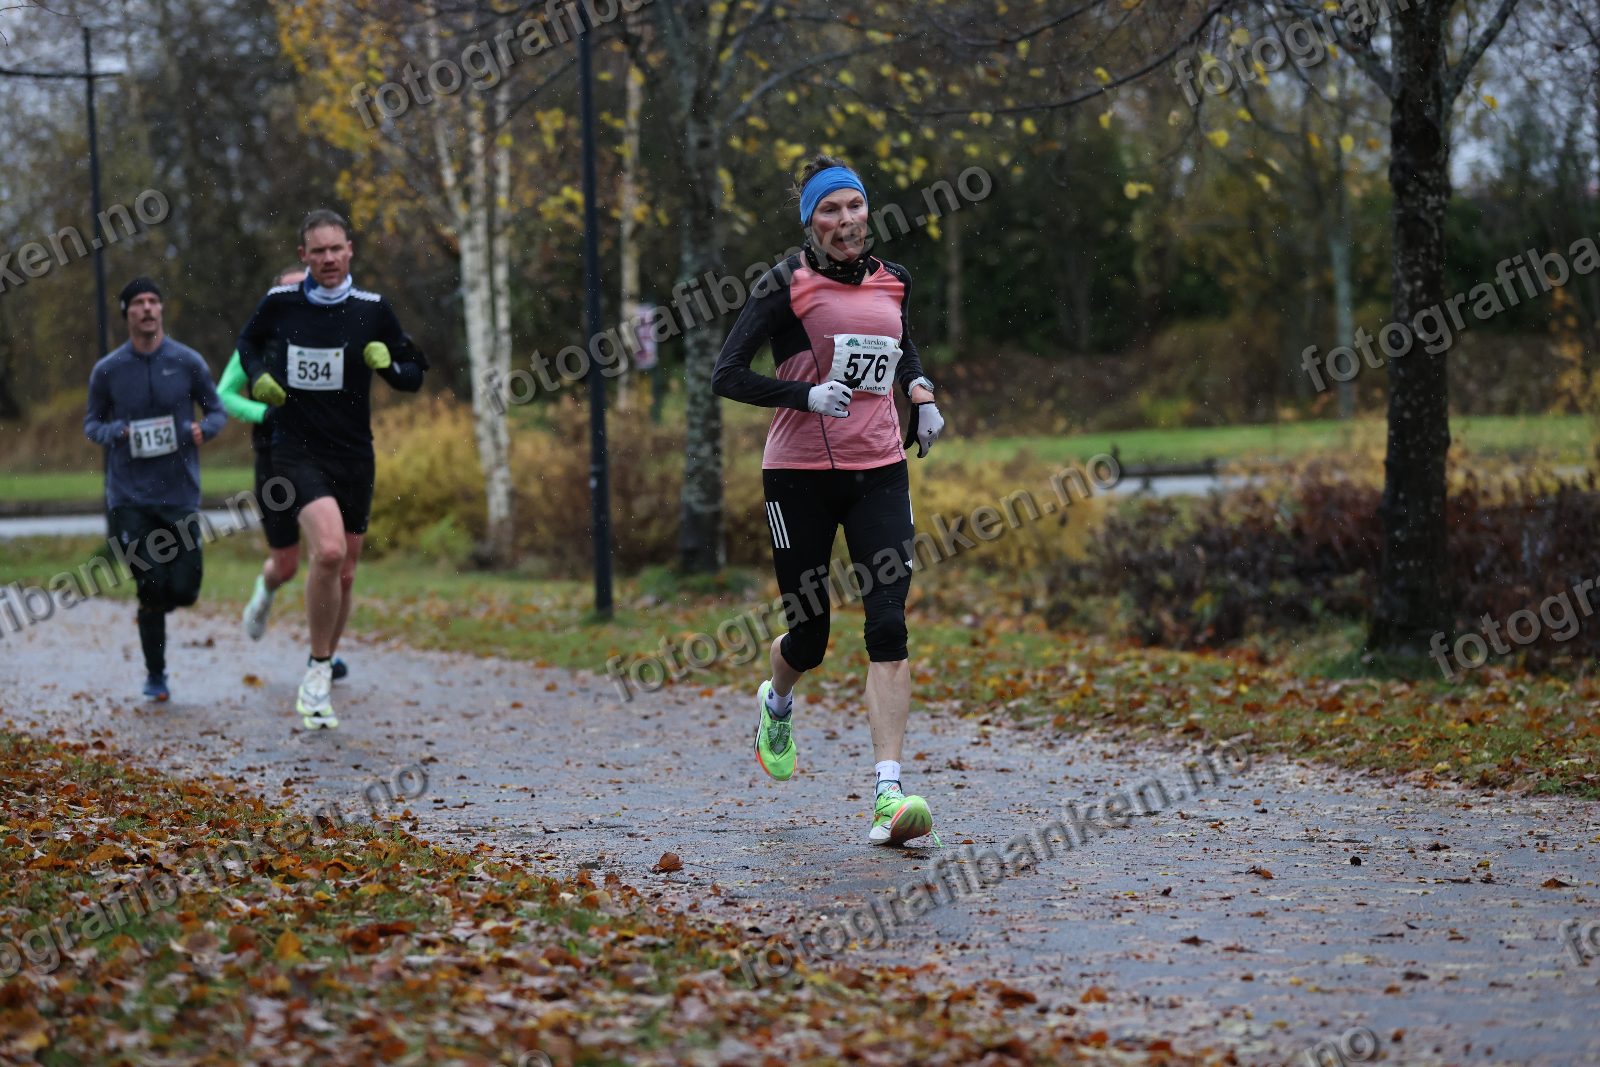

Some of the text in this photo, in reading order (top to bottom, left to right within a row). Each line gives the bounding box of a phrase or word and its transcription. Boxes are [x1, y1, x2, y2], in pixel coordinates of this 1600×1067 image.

[297, 360, 331, 381] 534
[843, 353, 889, 383] 576
[133, 426, 172, 449] 9152
